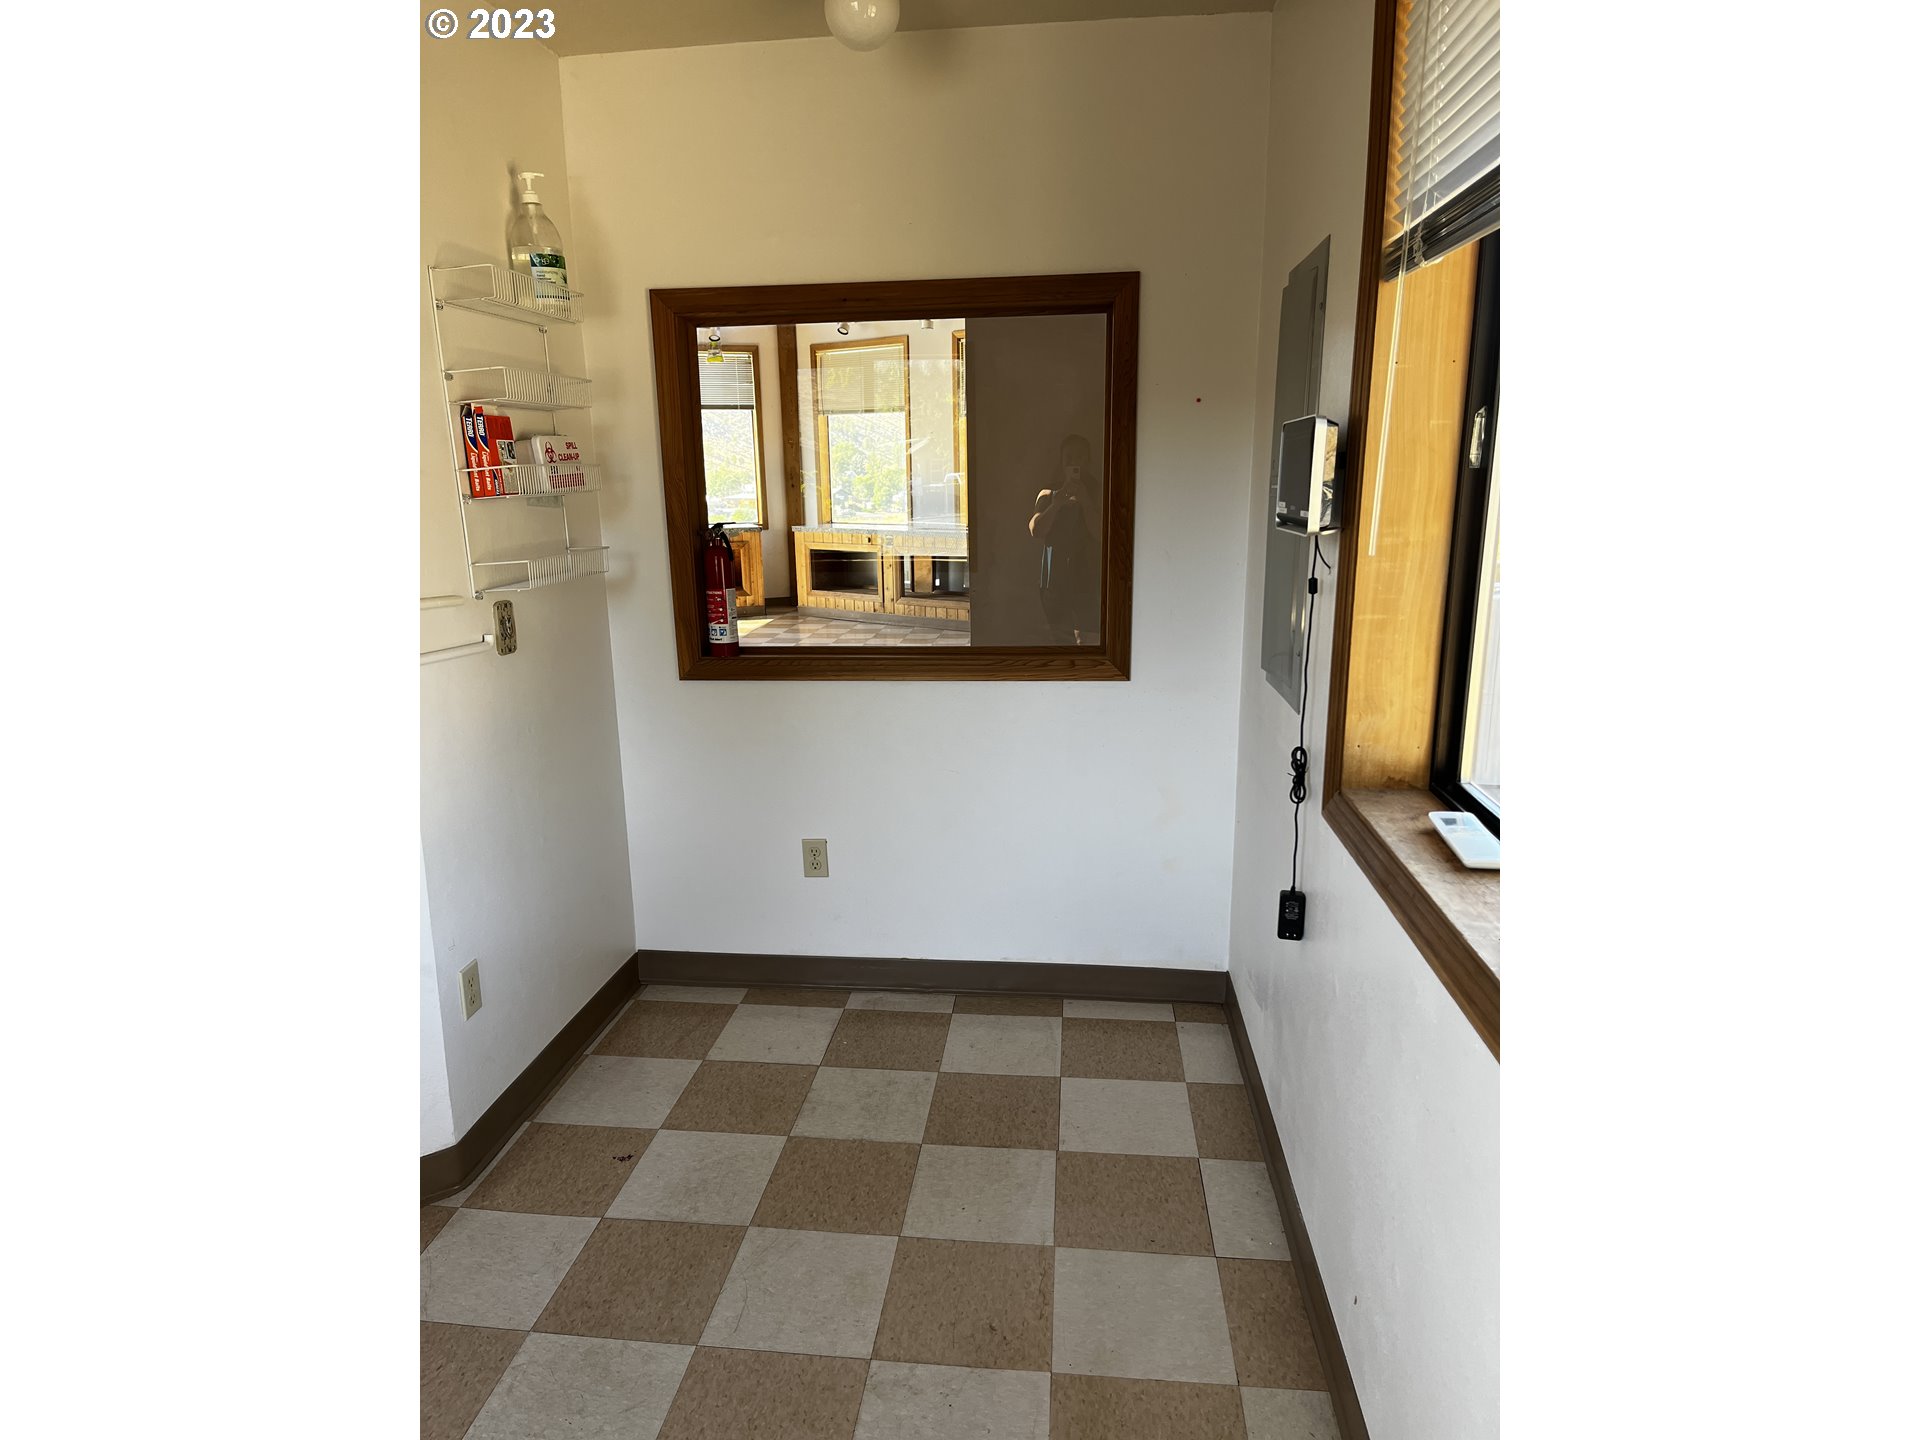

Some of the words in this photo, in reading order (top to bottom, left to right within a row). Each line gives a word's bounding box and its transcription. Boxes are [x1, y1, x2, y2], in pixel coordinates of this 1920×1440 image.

[466, 417, 475, 437] TERRO
[477, 416, 486, 436] TERRO
[565, 442, 578, 450] SPILL
[558, 453, 580, 461] CLEAN-UP
